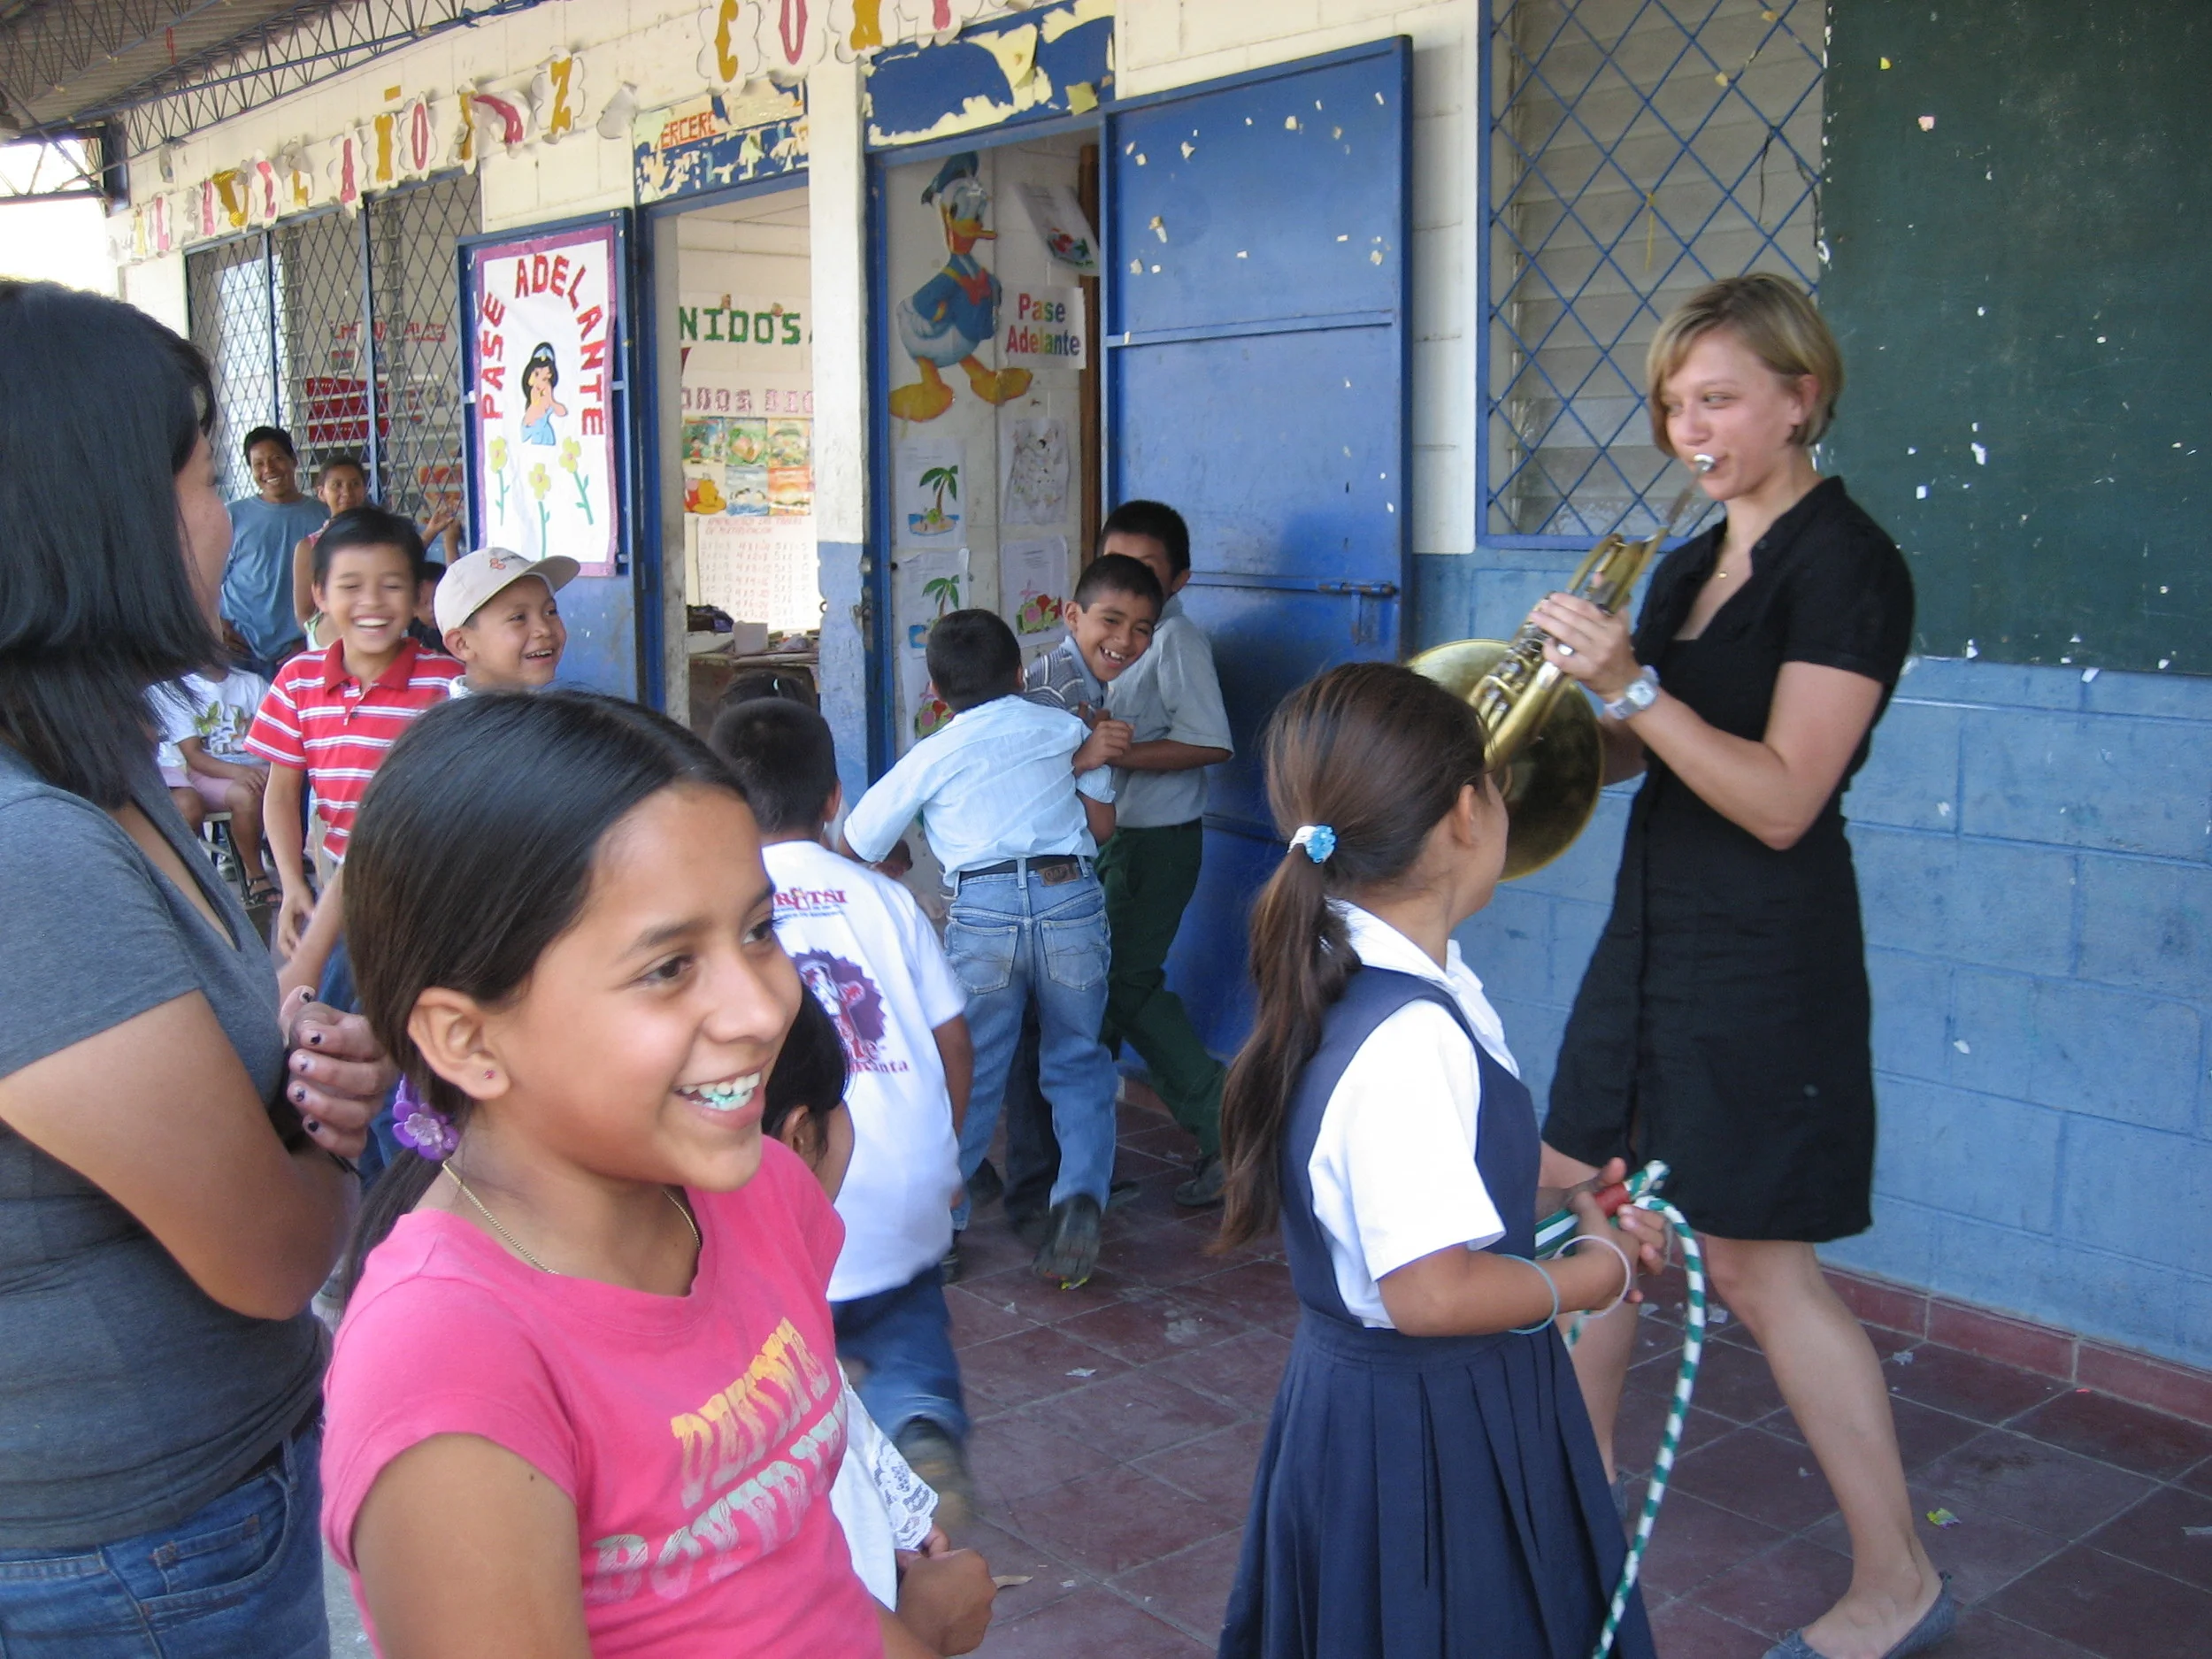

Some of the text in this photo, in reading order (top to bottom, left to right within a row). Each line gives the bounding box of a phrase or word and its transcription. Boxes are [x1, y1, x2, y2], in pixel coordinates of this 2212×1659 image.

[1018, 293, 1065, 322] Pase
[480, 253, 607, 435] PASE ADELANTE
[1006, 325, 1080, 356] Adelante
